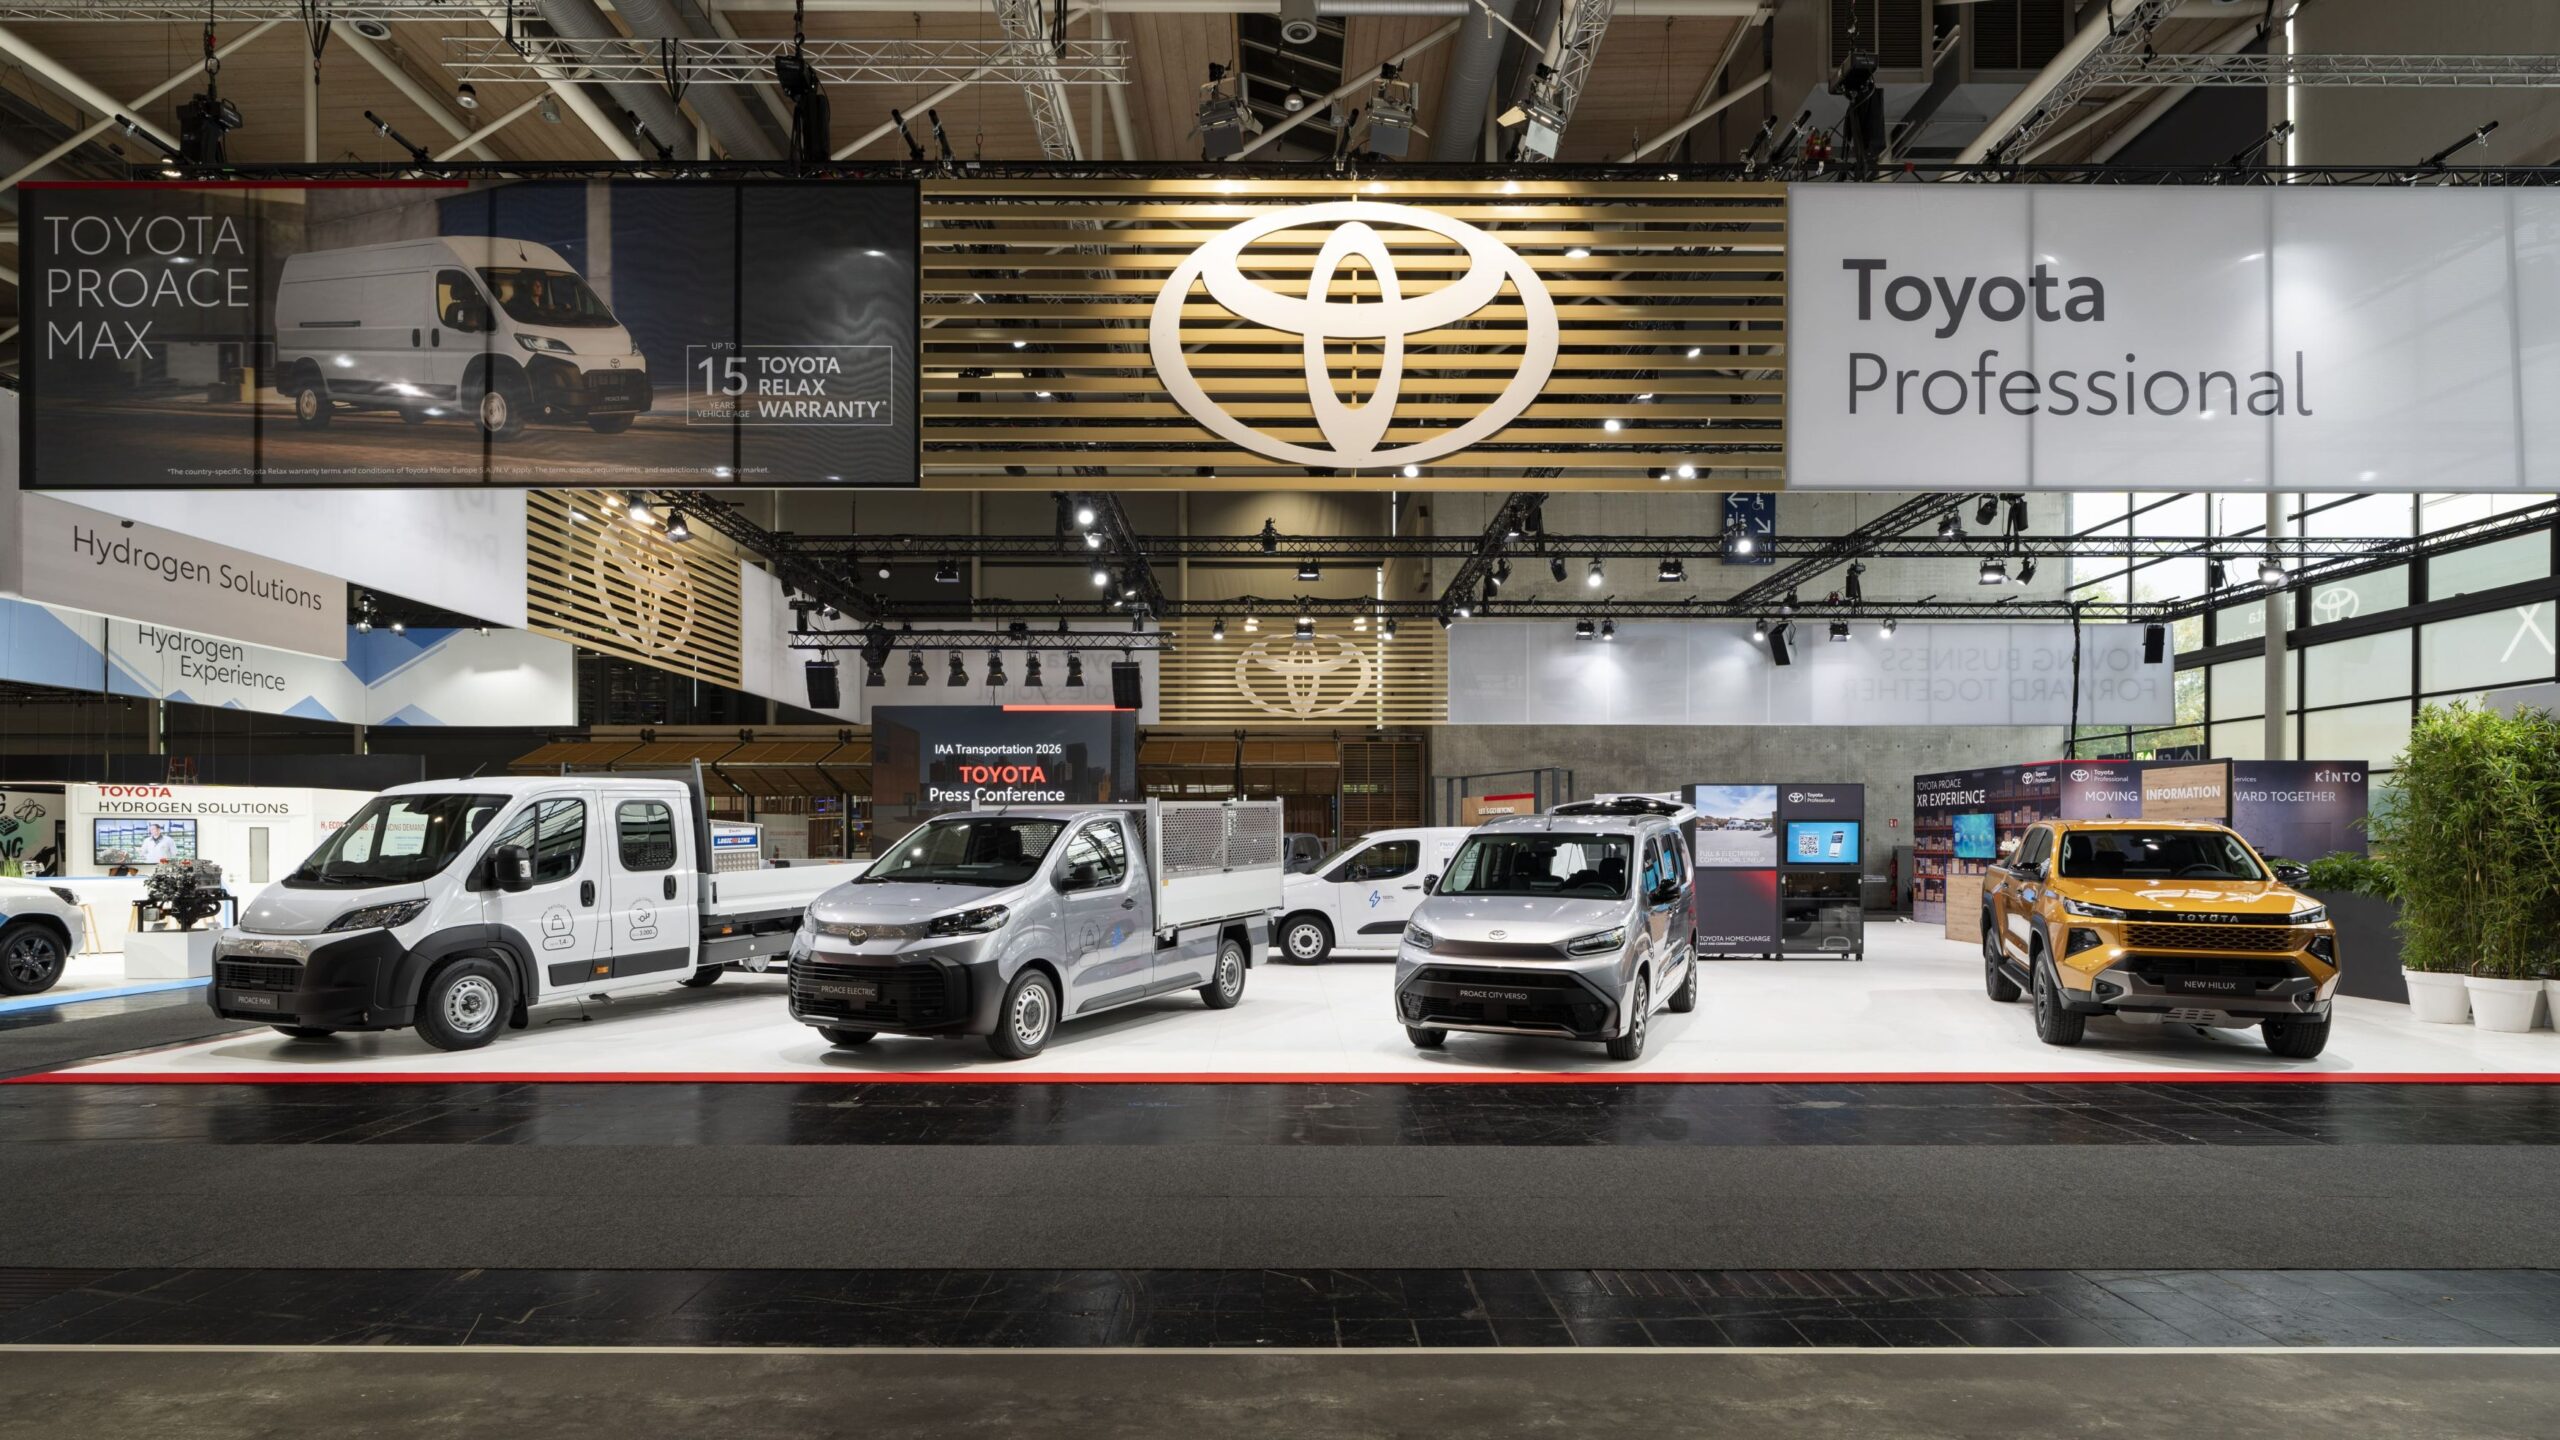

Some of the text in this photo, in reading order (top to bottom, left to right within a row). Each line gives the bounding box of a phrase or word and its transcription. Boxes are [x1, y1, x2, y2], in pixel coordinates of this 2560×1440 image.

[43, 215, 244, 255] TOYOTA
[48, 268, 249, 308] PROACE
[1842, 258, 2105, 339] Toyota
[48, 321, 153, 359] MAX
[711, 342, 736, 350] UP TO
[758, 356, 841, 374] TOYOTA
[698, 356, 748, 396] 15
[1848, 350, 2313, 417] Professional
[758, 379, 826, 396] RELAX
[710, 401, 736, 409] YEARS
[697, 410, 731, 418] VEHICLE
[185, 468, 242, 476] country-specific
[244, 468, 266, 476] Toyota
[288, 468, 320, 476] warranty
[406, 467, 428, 476] Toyota
[452, 467, 477, 476] Europe
[74, 525, 322, 611] Hydrogen Solutions
[138, 624, 243, 662] Hydrogen
[180, 655, 286, 692] Experience
[934, 744, 1062, 756] IAA Transportation 2026
[959, 766, 1046, 783] TOYOTA
[1916, 778, 1961, 790] TOYOTA PROACE
[98, 786, 172, 798] TOYOTA
[929, 787, 1065, 802] Press Conference
[1916, 790, 1985, 807] XR EXPERIENCE
[2085, 791, 2138, 802] MOVING
[2270, 791, 2336, 802] TOGETHER
[2146, 785, 2221, 800] INFORMATION
[99, 801, 289, 814] HYDROGEN SOLUTIONS
[2177, 913, 2239, 923] TOYOTA
[821, 985, 876, 996] PROACE ELECTRIC
[2184, 981, 2236, 990] NEW HILUX
[238, 996, 271, 1005] PROACE MAX
[1460, 990, 1528, 1000] PROACE CITY VERSO
